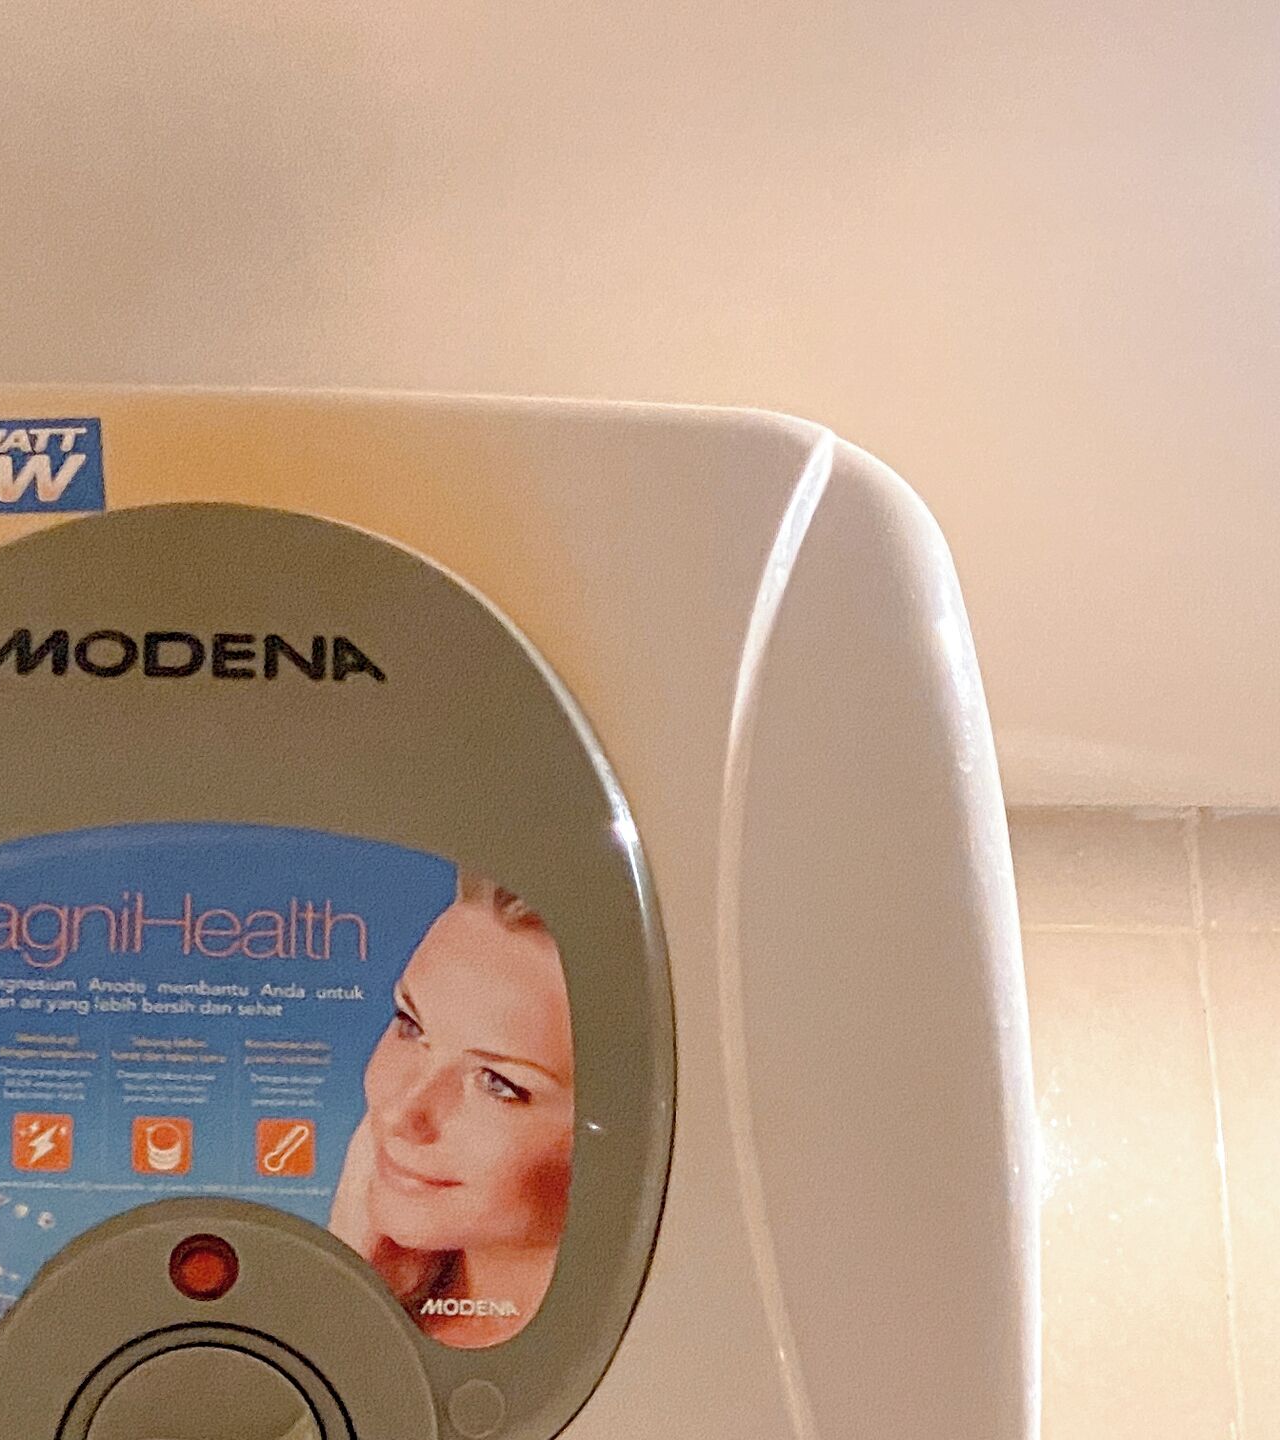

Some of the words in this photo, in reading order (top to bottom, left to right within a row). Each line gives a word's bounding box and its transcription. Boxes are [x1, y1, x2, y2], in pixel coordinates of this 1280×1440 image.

[157, 980, 250, 997] membantu
[261, 982, 306, 999] Anda
[316, 984, 364, 1000] untuk
[45, 1000, 90, 1016] yang
[94, 997, 137, 1012] lebih
[142, 997, 196, 1014] bersih
[200, 1000, 232, 1016] dan
[238, 1001, 284, 1018] sehat
[420, 1298, 520, 1317] MODENA
